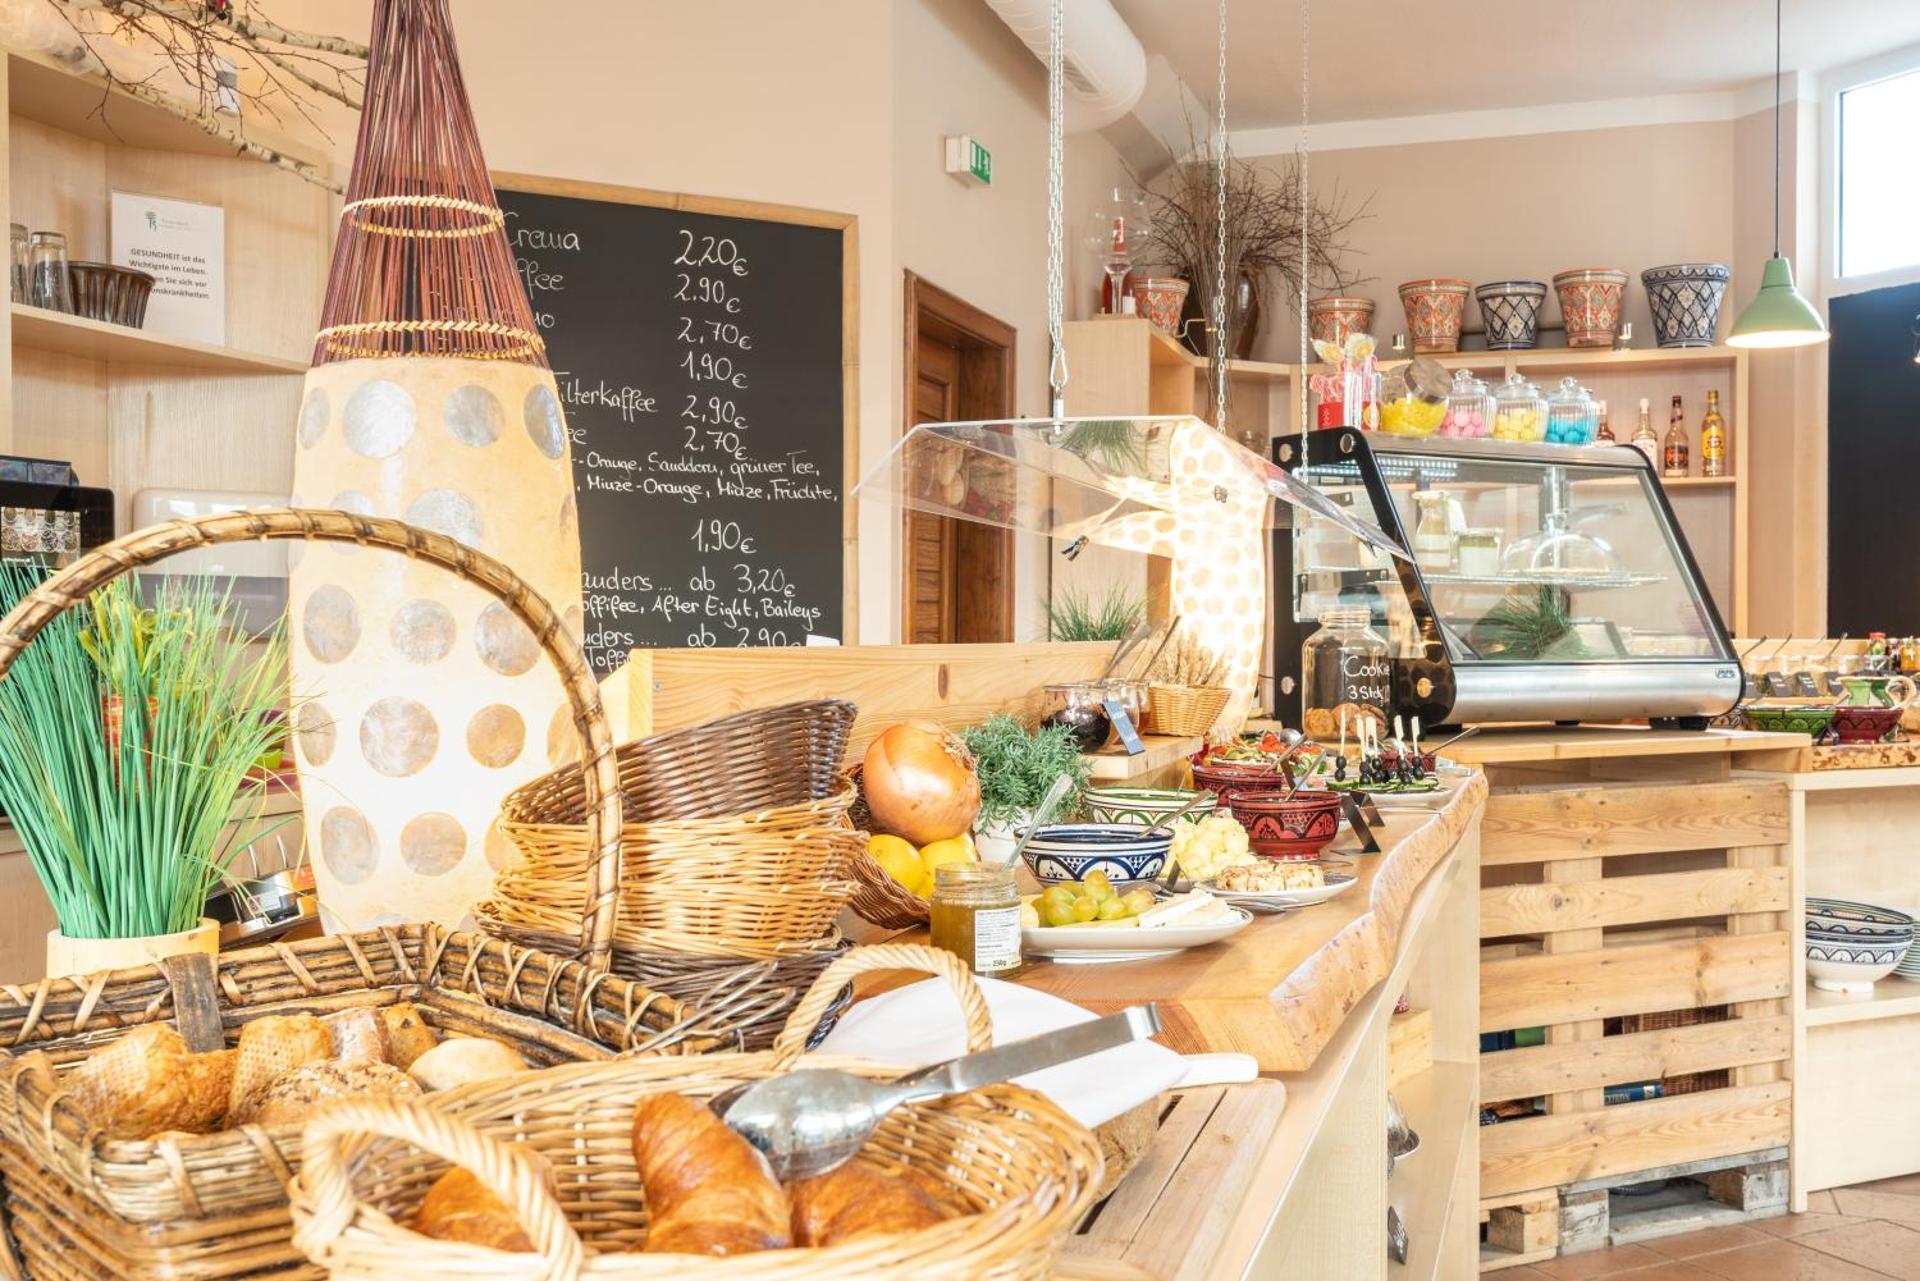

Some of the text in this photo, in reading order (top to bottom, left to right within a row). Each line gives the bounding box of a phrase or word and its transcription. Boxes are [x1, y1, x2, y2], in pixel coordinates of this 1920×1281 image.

[128, 259, 170, 271] Wichtigste
[130, 248, 206, 264] GESUNDHEIT ist das
[677, 317, 752, 349] 2,70€
[681, 351, 748, 389] 1,90€
[554, 373, 659, 423] ilterkaffee
[681, 395, 749, 429] 2,90€
[684, 426, 749, 461] 2,70€
[690, 518, 757, 554] 1,90€
[689, 565, 716, 592] ab
[733, 563, 796, 598] 3,20€
[651, 594, 701, 623] After
[705, 594, 759, 629] Eight,
[760, 597, 822, 632] Baileys
[687, 622, 717, 648] ab
[1347, 684, 1359, 700] 3
